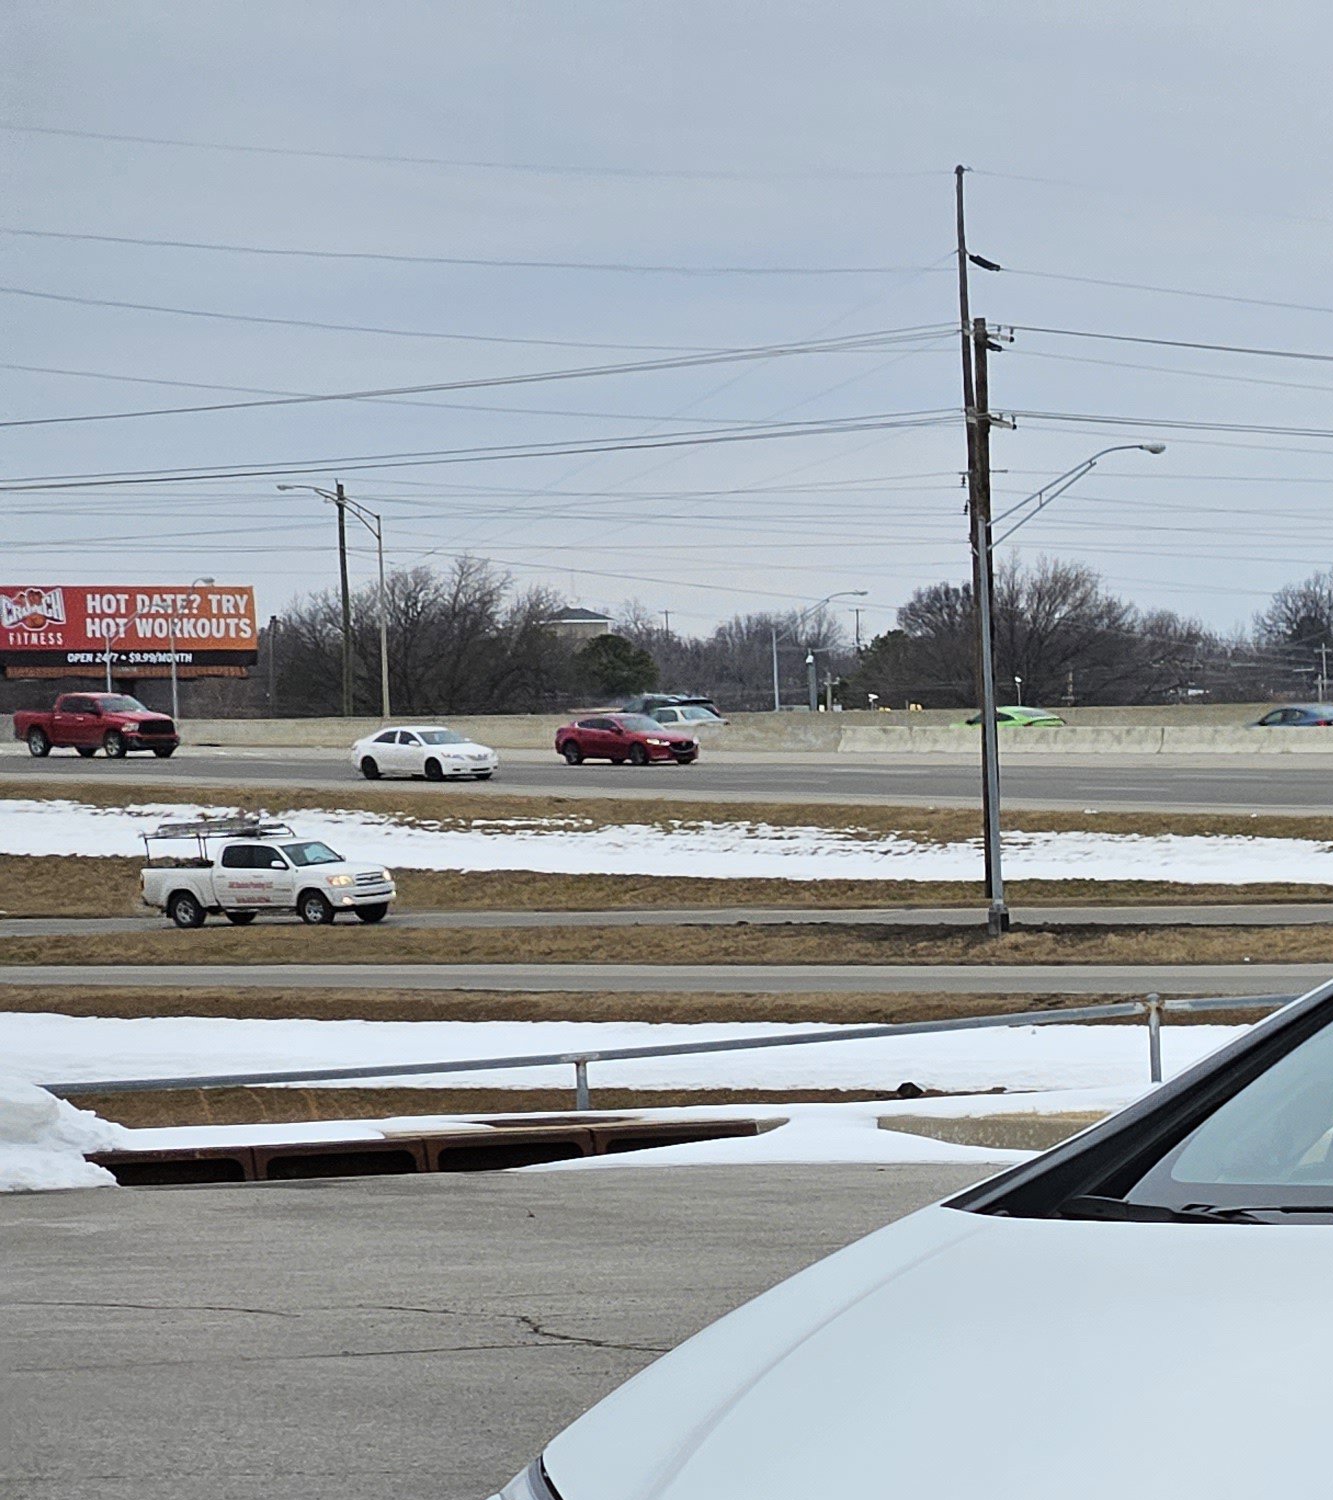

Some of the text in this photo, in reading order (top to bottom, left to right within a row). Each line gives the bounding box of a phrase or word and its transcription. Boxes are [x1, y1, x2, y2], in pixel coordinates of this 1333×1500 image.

[86, 594, 248, 615] HOT DATE? TRY
[86, 618, 252, 639] HOT WORKOUTS
[9, 632, 63, 646] FITNESS
[67, 653, 93, 663] OPEN
